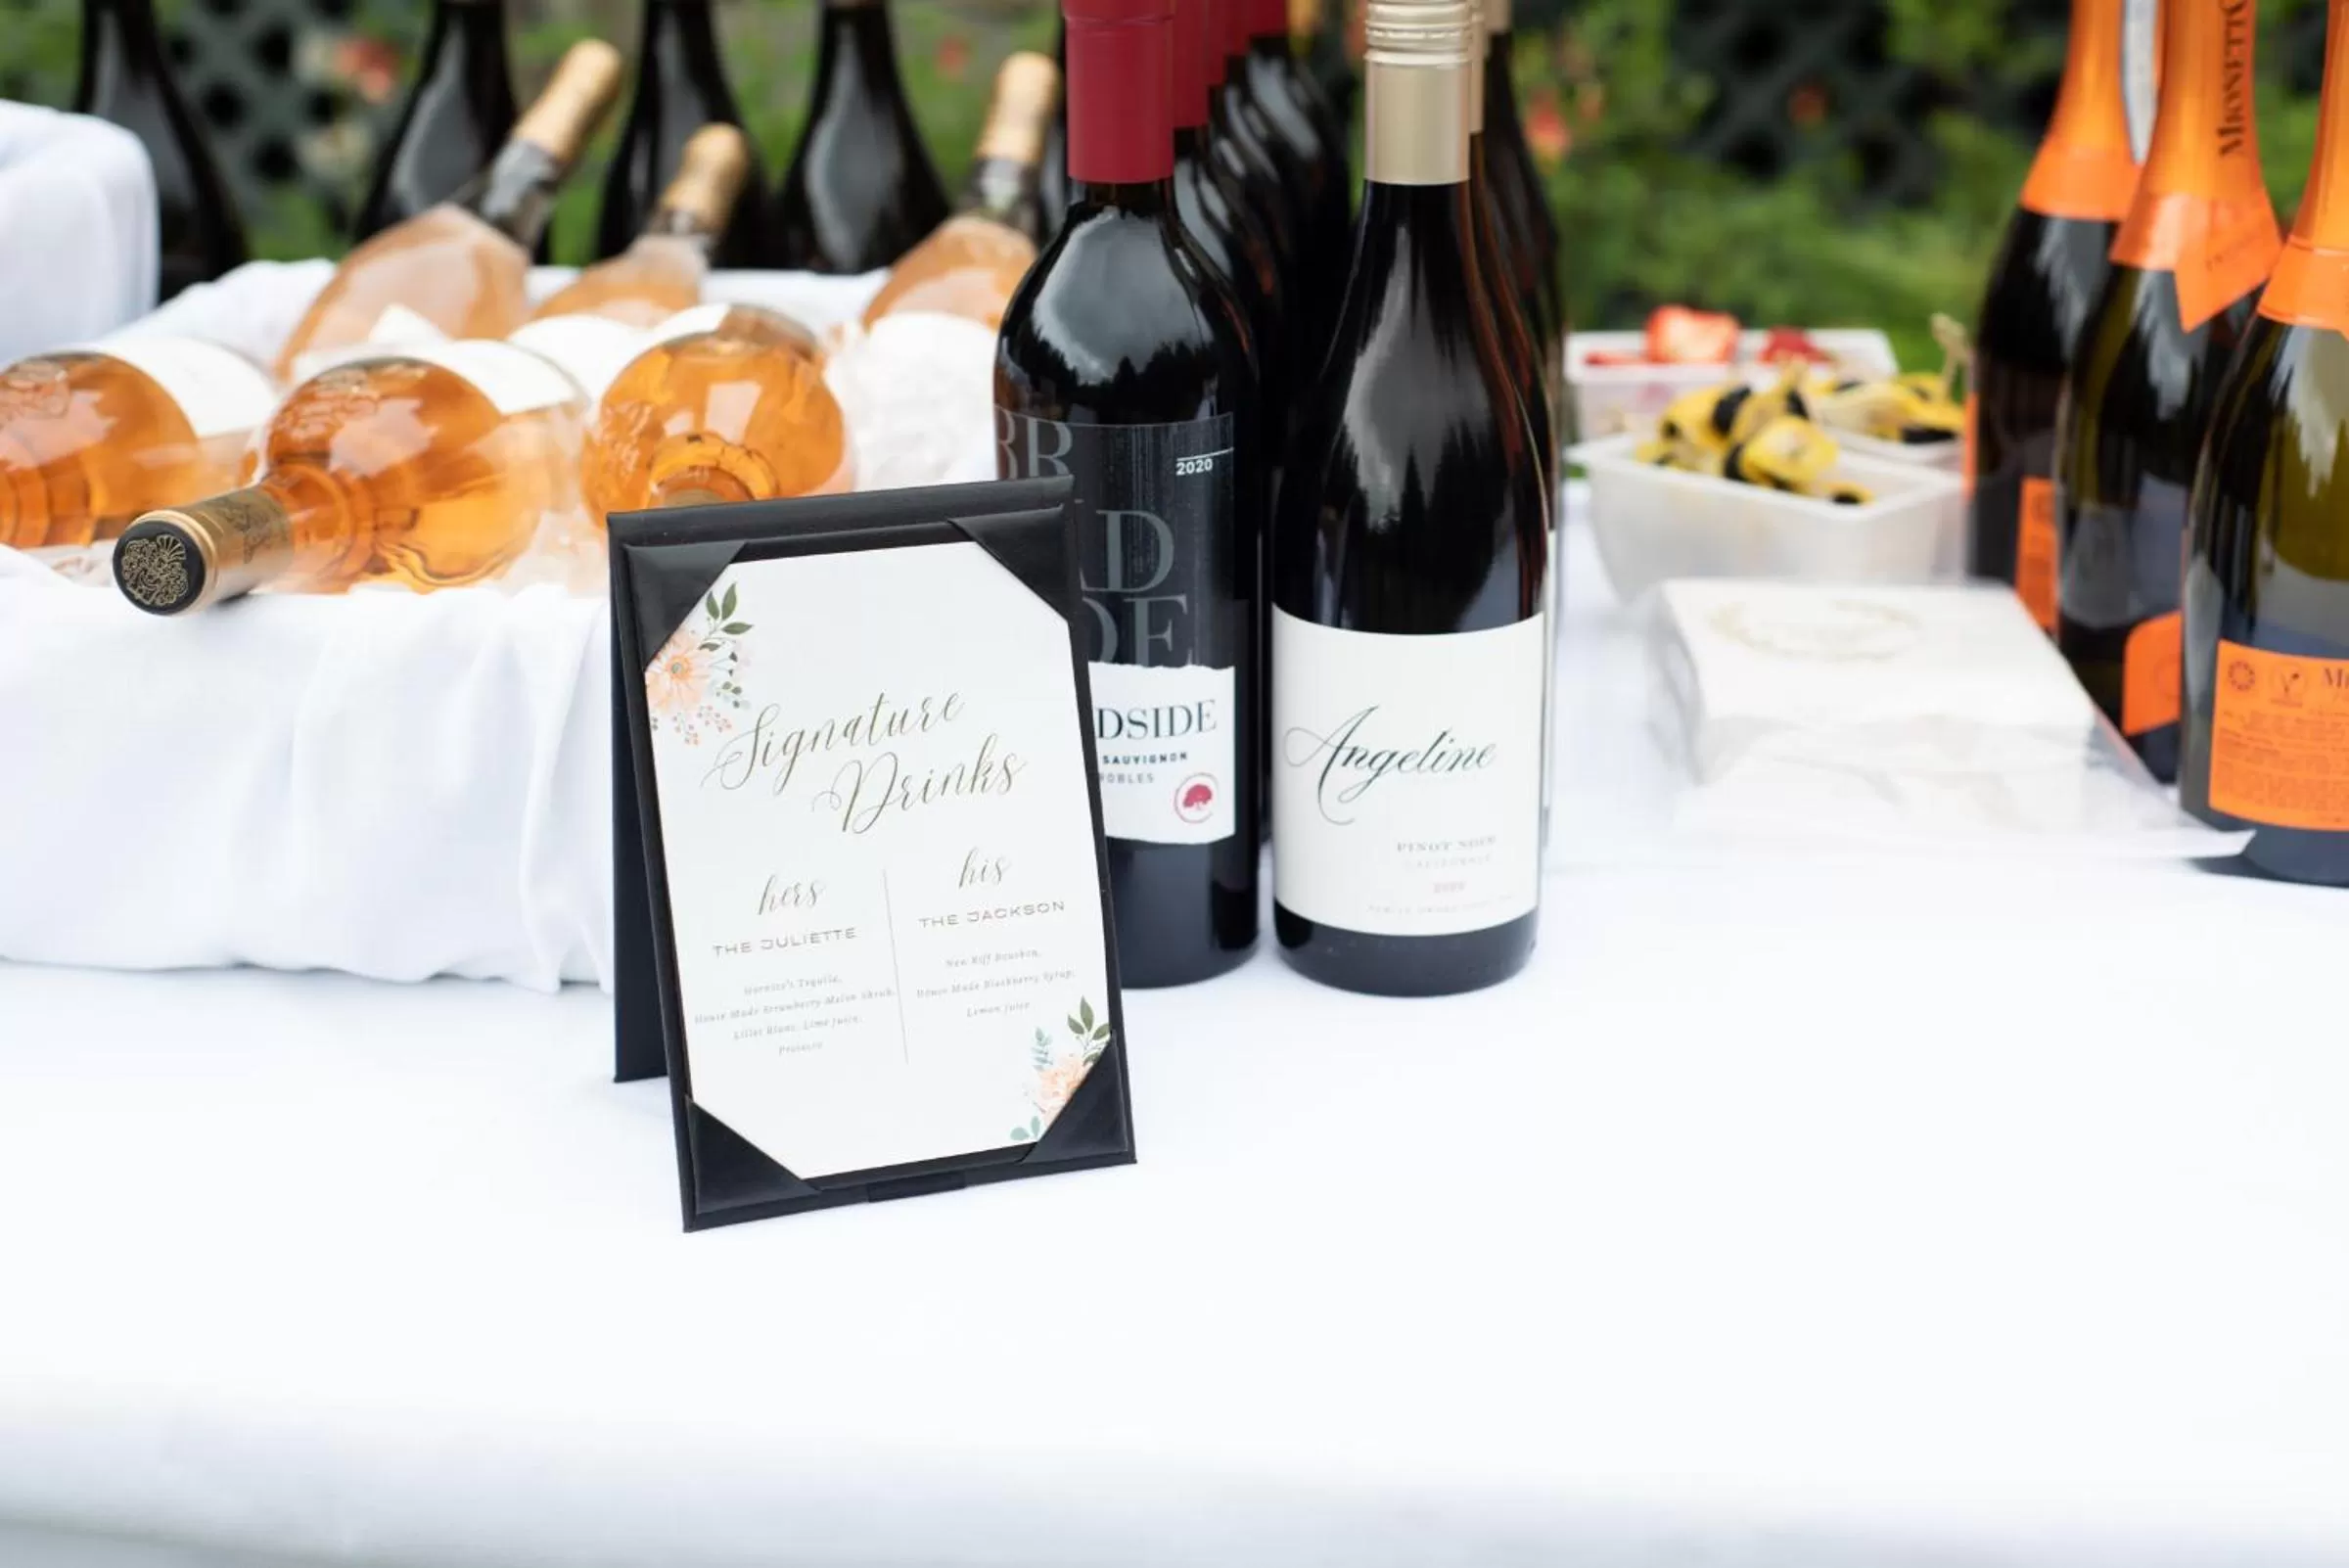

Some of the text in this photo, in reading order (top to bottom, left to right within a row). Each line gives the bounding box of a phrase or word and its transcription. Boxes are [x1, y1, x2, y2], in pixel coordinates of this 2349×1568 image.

[1175, 458, 1214, 476] 2020
[700, 690, 965, 796] Signature
[1102, 752, 1187, 764] SAUVIGNON
[811, 732, 1026, 835] Drinks
[1282, 704, 1497, 826] Angeline
[958, 846, 1010, 889] his
[759, 873, 826, 915] hers
[918, 899, 1066, 929] THE JACKSON
[713, 927, 857, 958] THE JULIETTE
